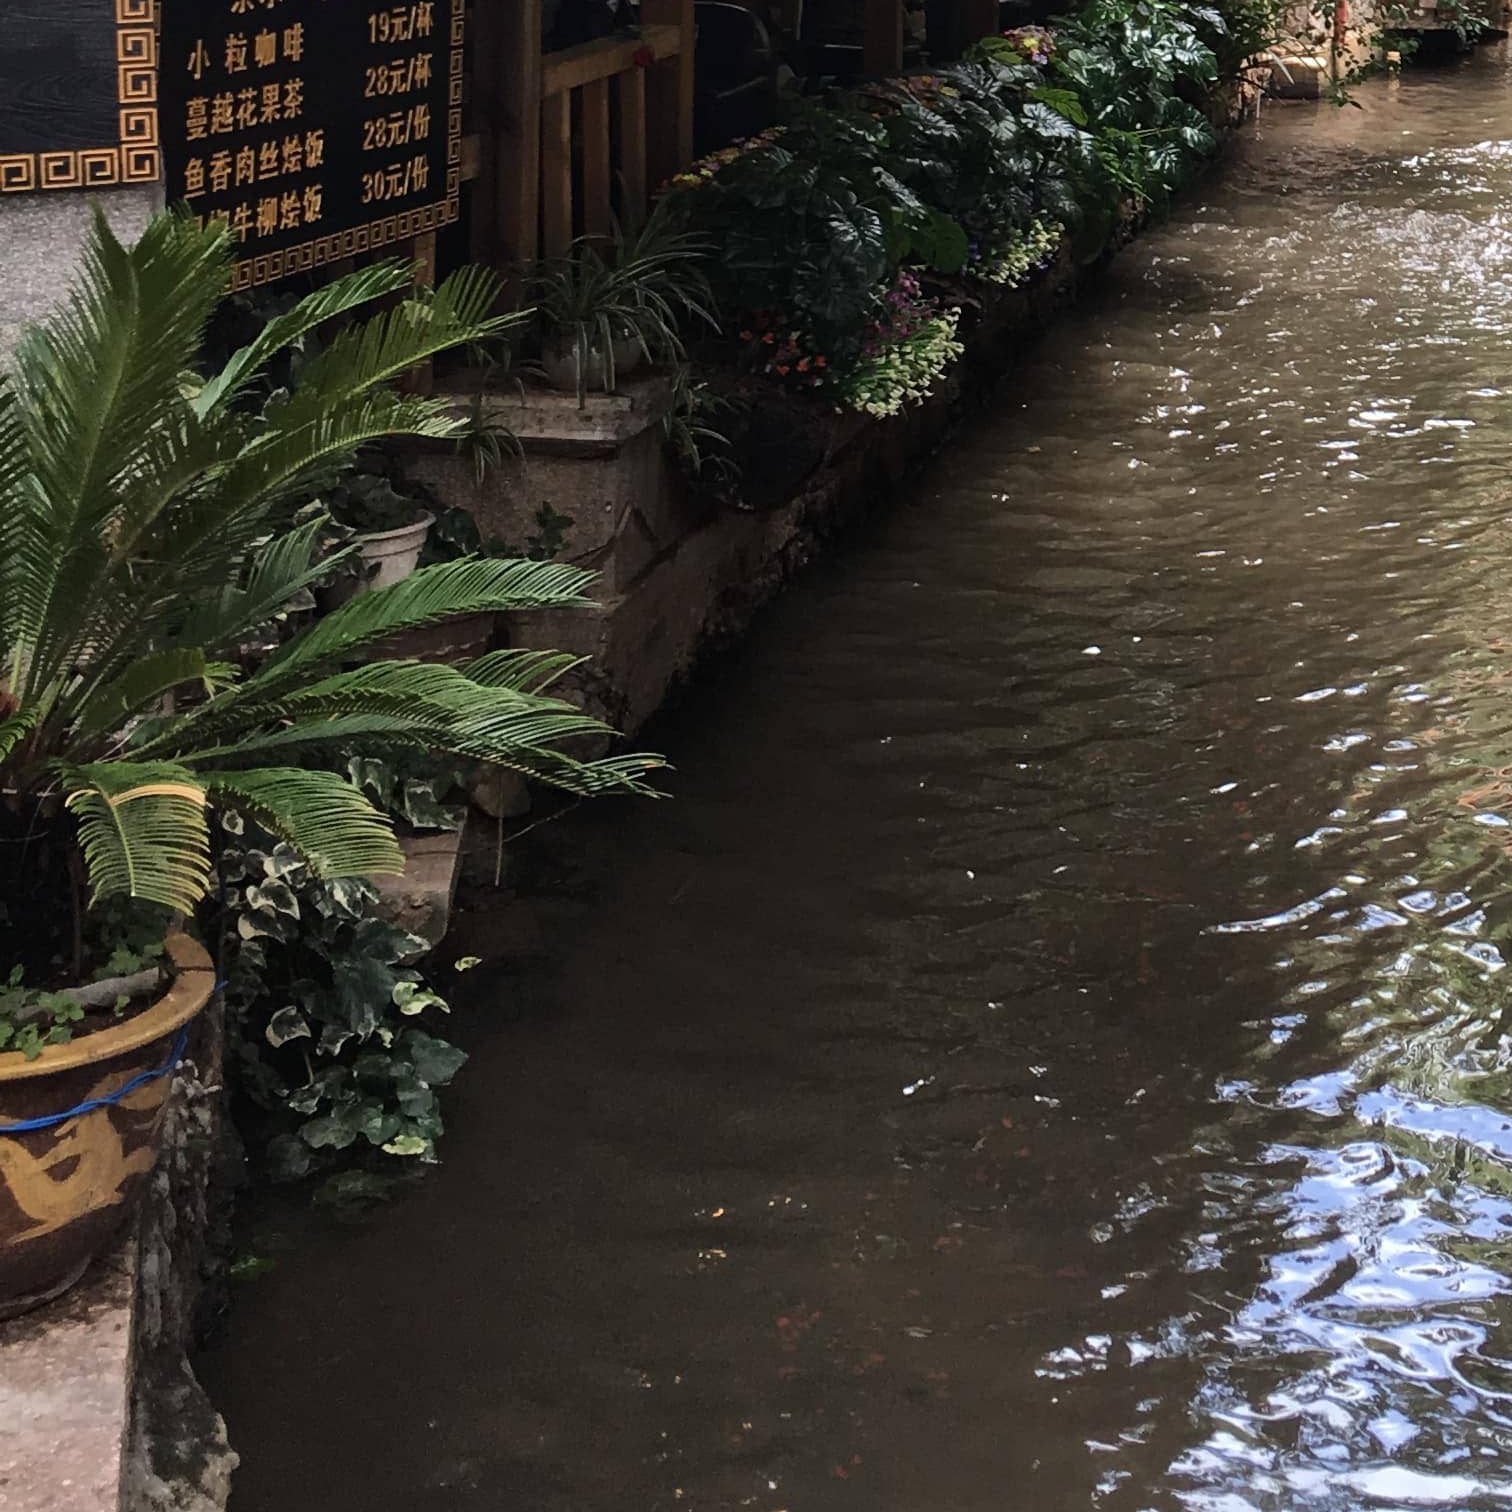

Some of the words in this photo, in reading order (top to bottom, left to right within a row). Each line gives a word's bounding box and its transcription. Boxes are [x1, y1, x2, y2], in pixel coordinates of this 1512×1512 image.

[368, 1, 434, 43] 19元/杯
[186, 78, 304, 141] 蔓越花果茶
[364, 53, 432, 97] 28元/杯
[184, 129, 325, 199] 鱼香肉丝烩饭
[362, 104, 430, 150] 28元/份
[361, 155, 429, 201] 30元/份
